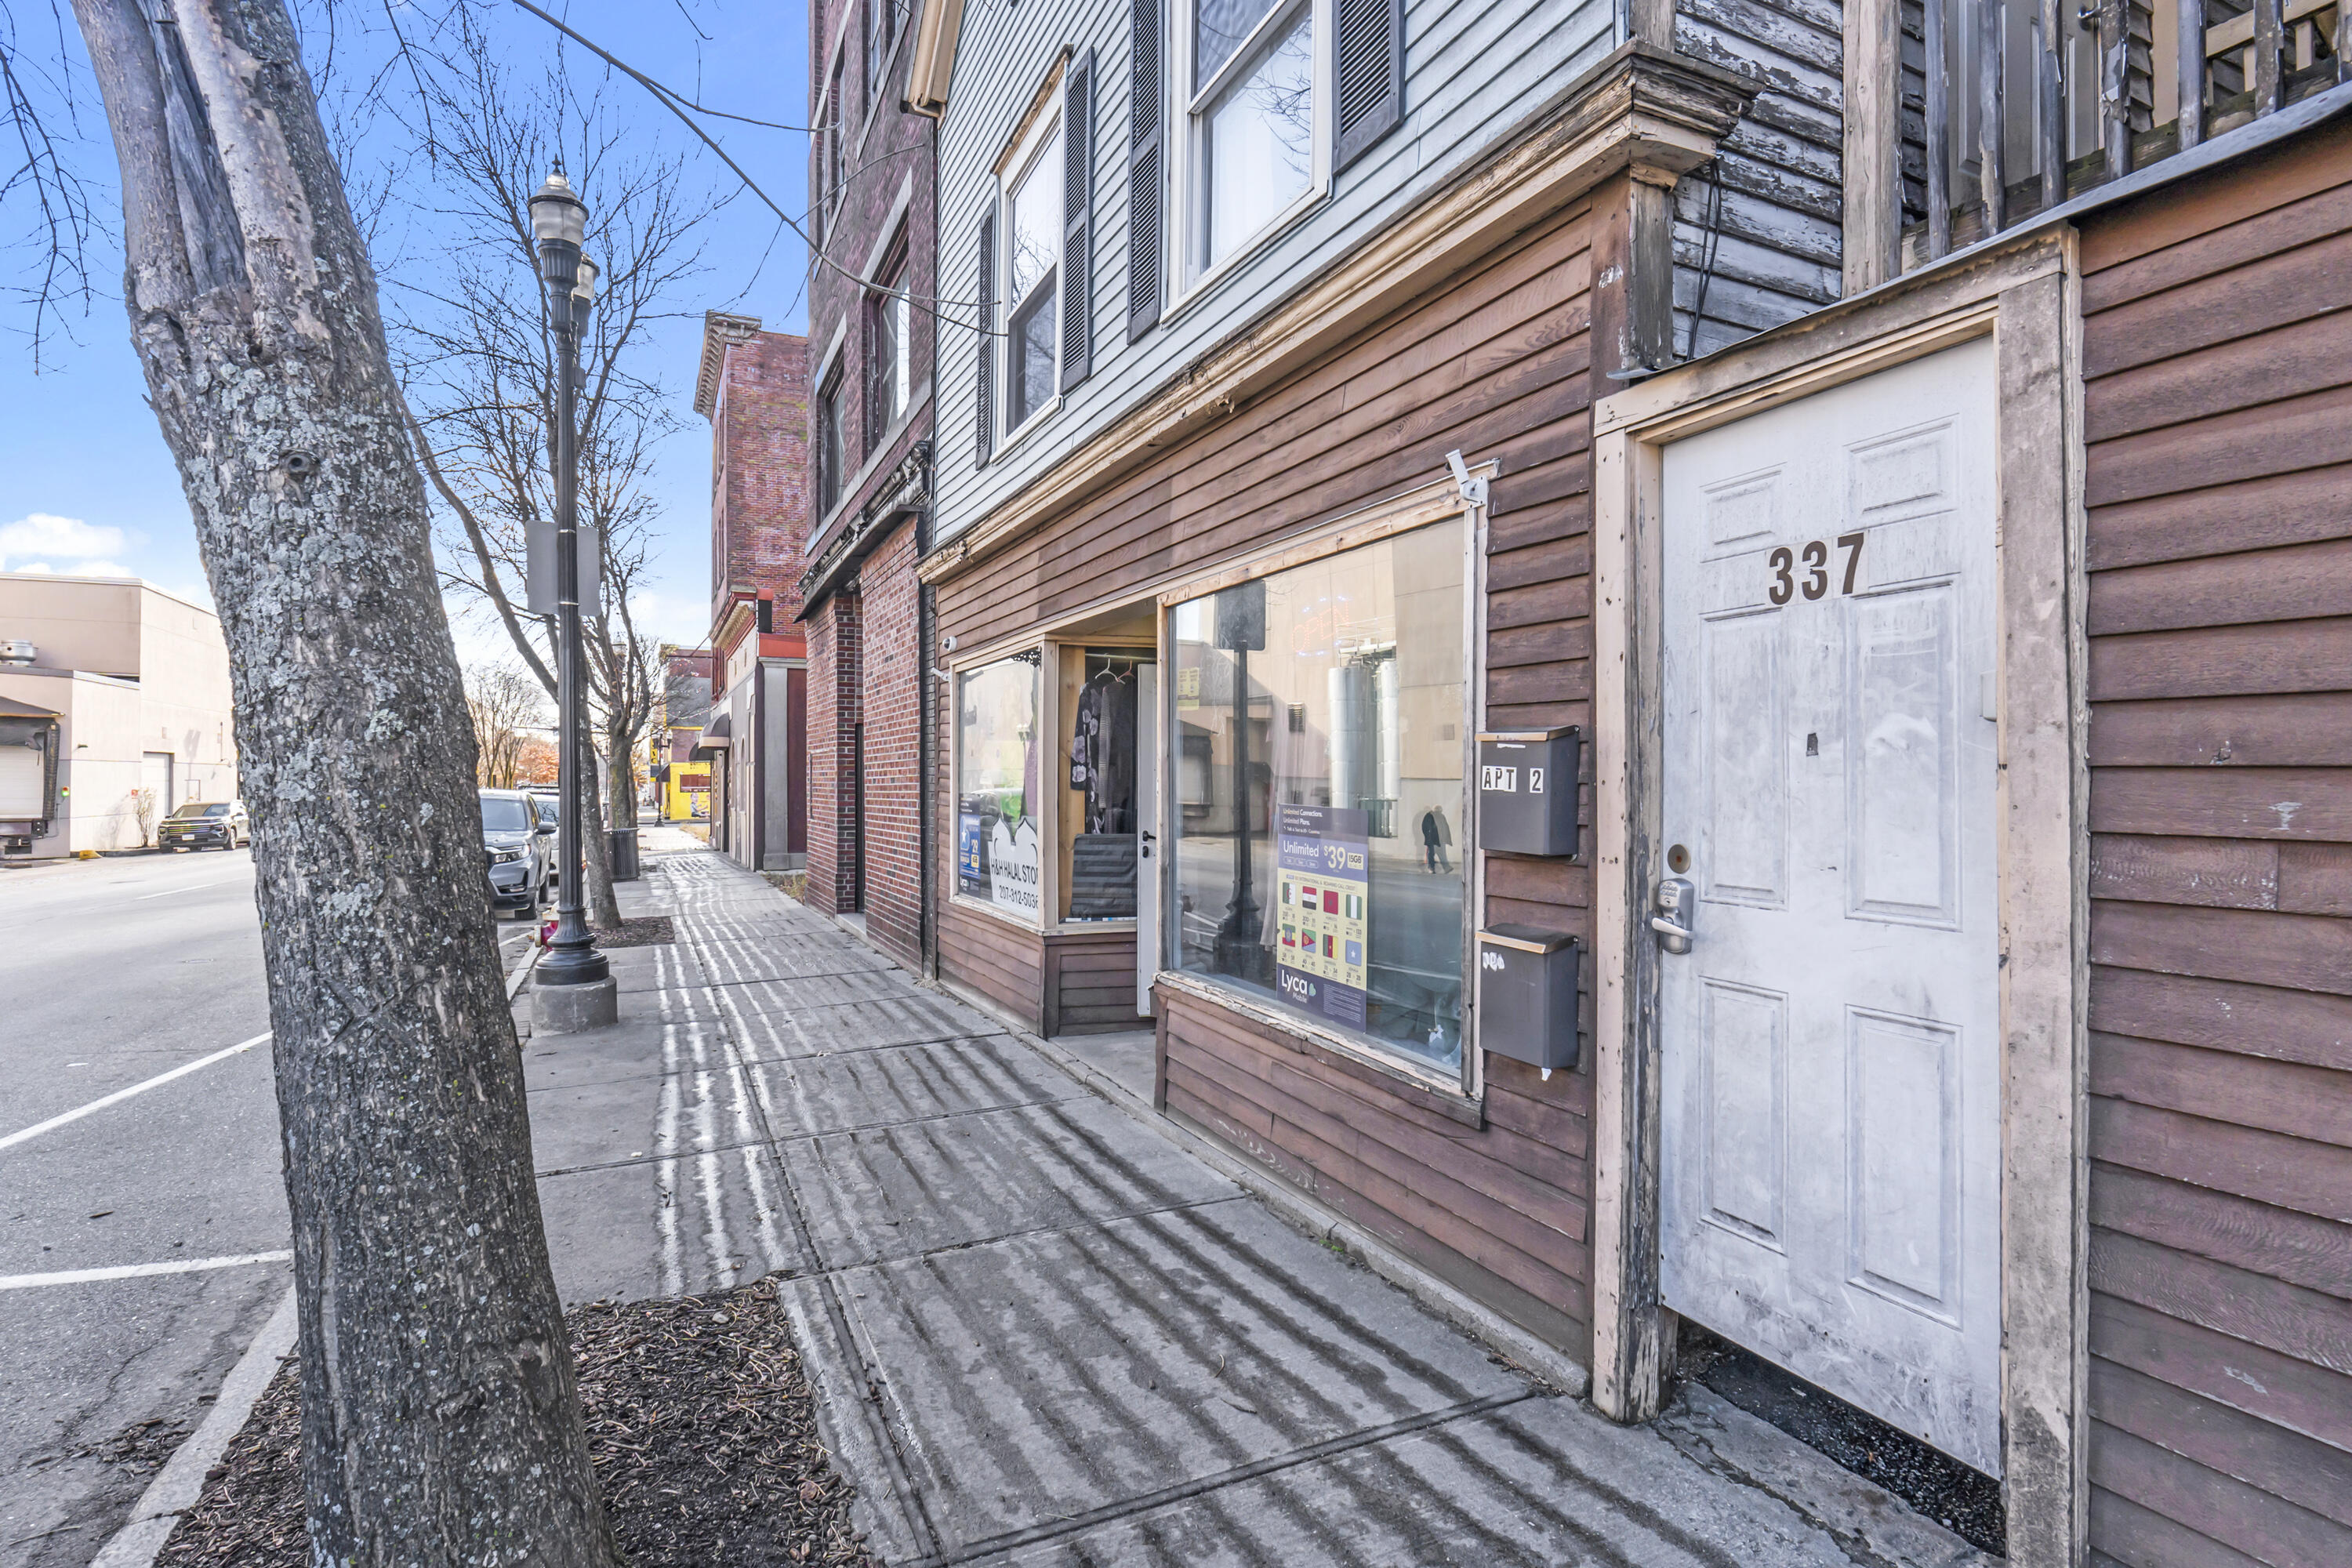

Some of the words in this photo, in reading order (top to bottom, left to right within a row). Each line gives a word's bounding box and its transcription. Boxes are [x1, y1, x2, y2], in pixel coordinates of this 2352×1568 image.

[1769, 532, 1864, 604] 337
[1291, 601, 1349, 653] OPEN
[1484, 768, 1515, 789] APT
[1531, 770, 1541, 792] 2
[1283, 840, 1319, 857] Unlimited
[1323, 845, 1346, 869] $39
[991, 858, 1004, 876] H&H
[1004, 860, 1022, 881] HALAL
[1281, 969, 1308, 995] Lyca
[1292, 992, 1308, 1004] Mobile
